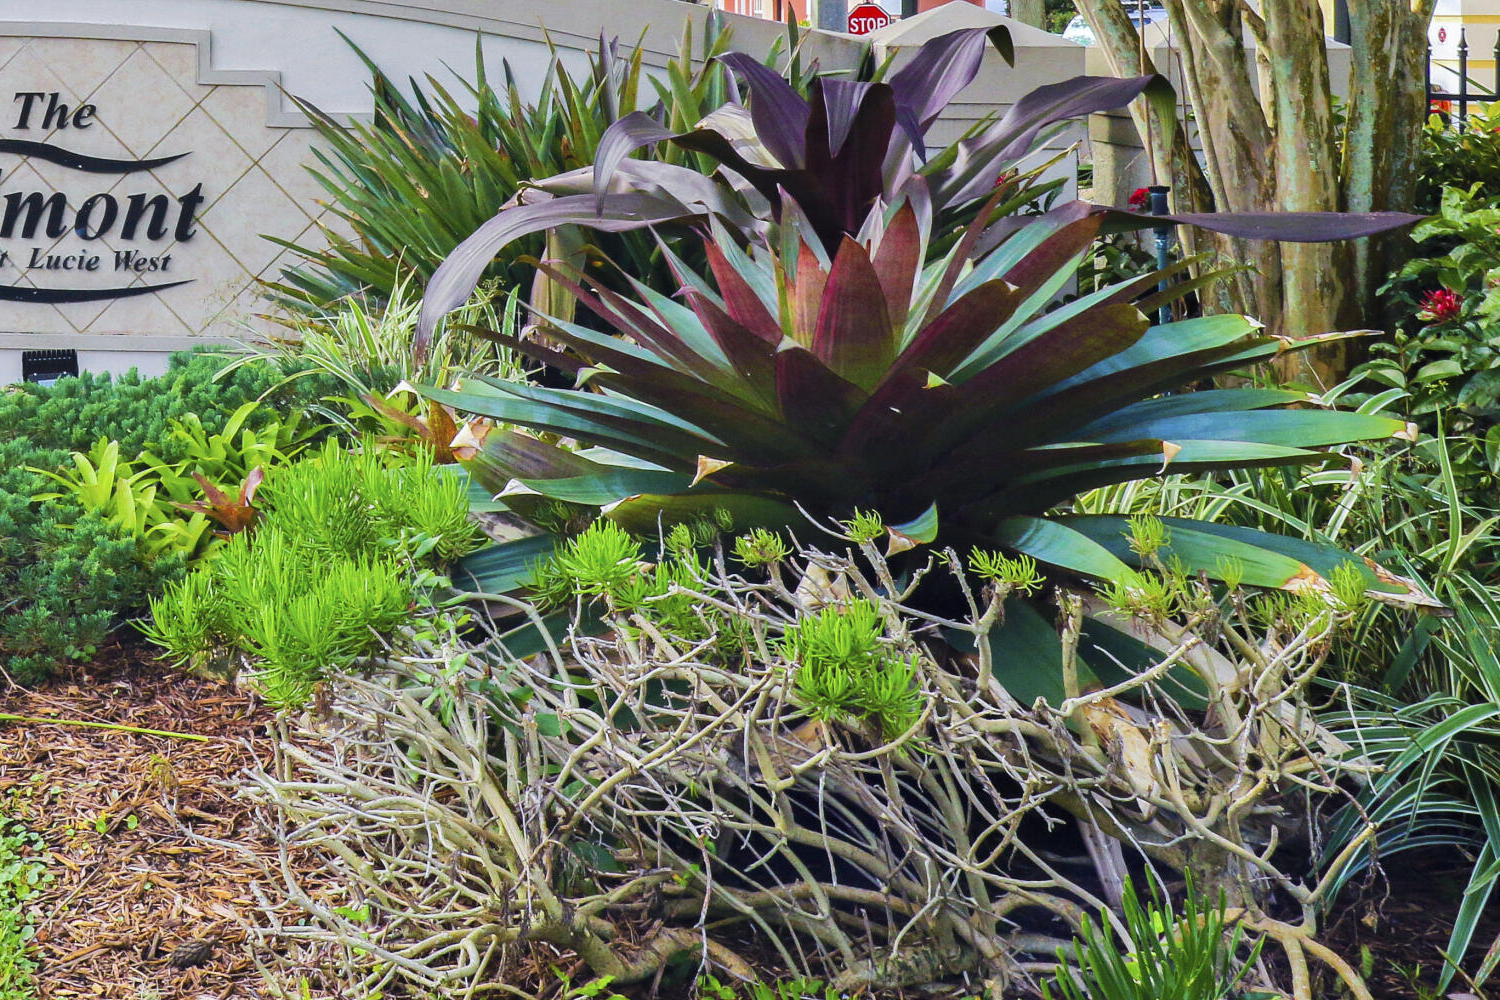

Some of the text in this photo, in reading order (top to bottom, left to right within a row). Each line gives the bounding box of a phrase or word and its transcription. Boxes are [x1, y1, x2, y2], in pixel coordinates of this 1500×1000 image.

[850, 17, 887, 33] STOP
[12, 92, 97, 131] The
[25, 247, 101, 272] Lucie
[113, 249, 172, 273] West
